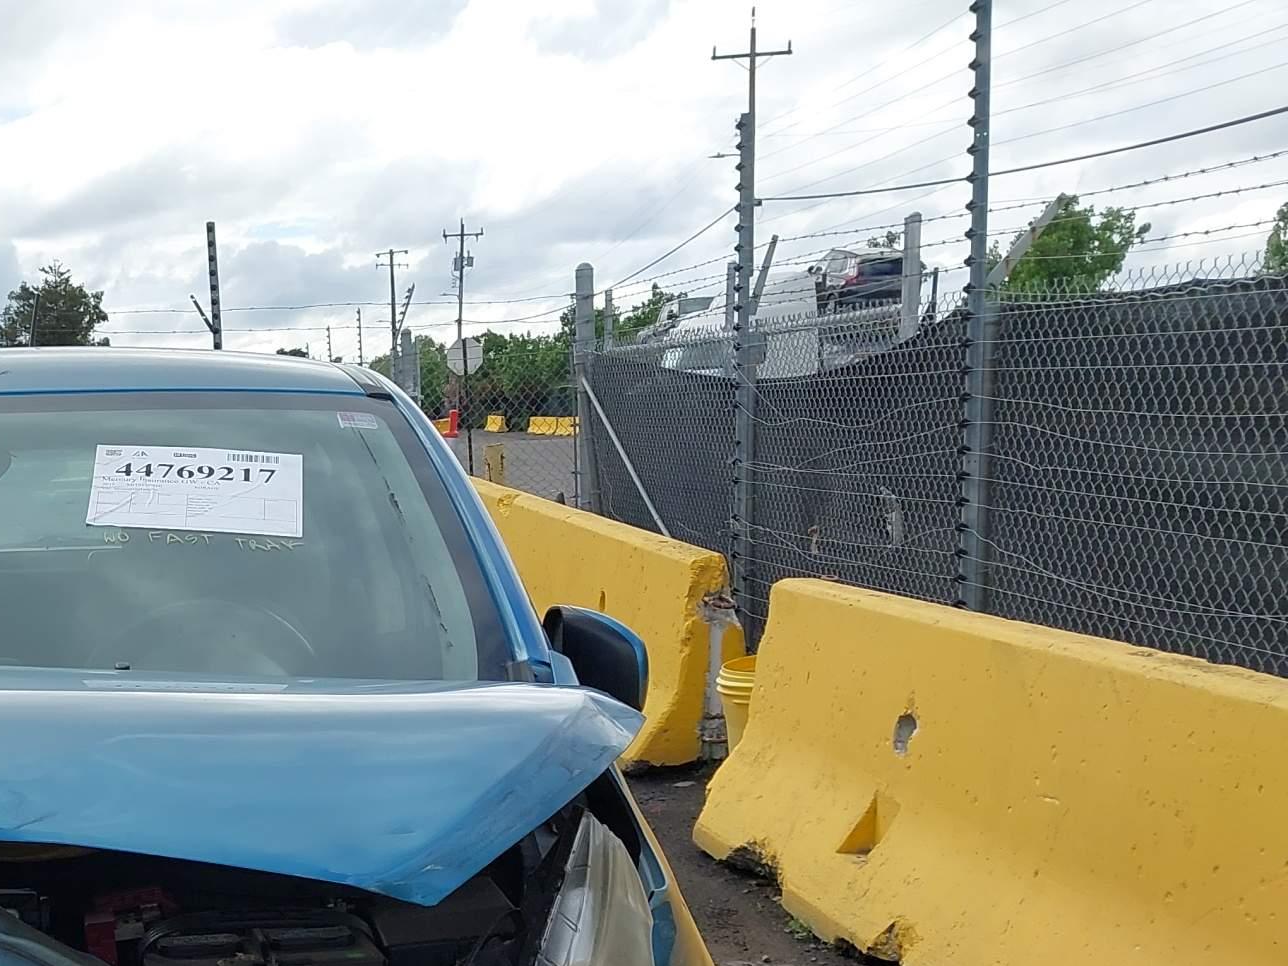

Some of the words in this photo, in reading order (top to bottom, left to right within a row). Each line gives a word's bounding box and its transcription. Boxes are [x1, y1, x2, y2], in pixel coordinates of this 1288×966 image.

[102, 475, 137, 483] Mercury
[139, 475, 179, 484] Insurance
[114, 462, 277, 484] 44769217
[149, 530, 214, 545] FAST
[235, 537, 304, 551] TRAK
